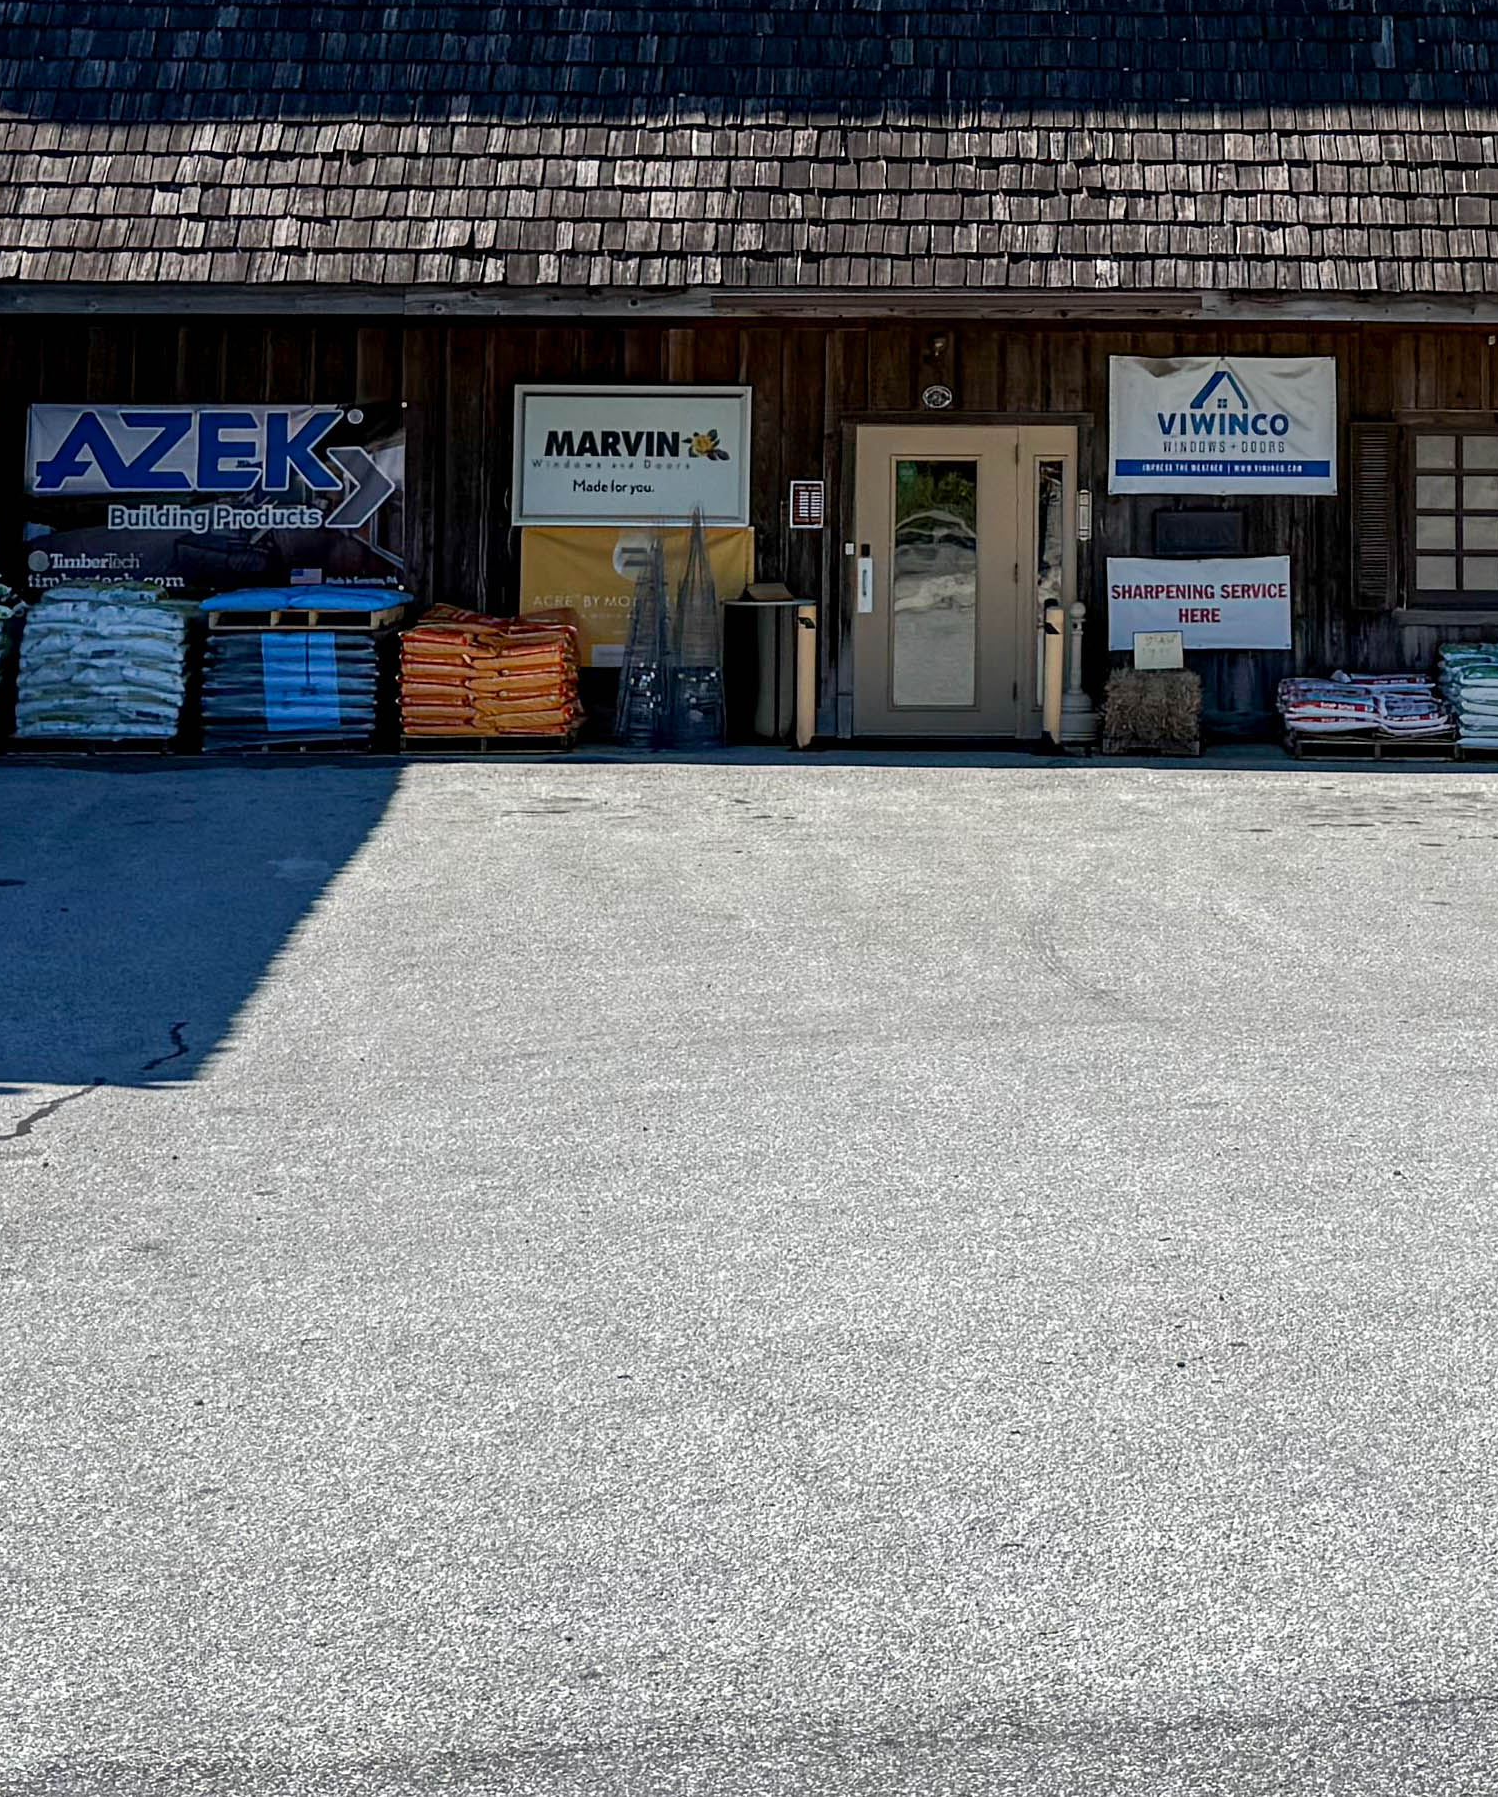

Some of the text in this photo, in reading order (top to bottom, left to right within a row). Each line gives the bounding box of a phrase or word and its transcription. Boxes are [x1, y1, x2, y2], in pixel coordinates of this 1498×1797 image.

[1157, 412, 1290, 436] VIWINCO
[32, 409, 345, 492] AZEK
[543, 430, 681, 458] MARVIN
[1163, 440, 1226, 453] WINDOWS
[1241, 441, 1285, 453] DOORS
[572, 480, 608, 493] Made
[108, 505, 323, 534] Building Products
[50, 552, 140, 569] TimberTech
[1111, 583, 1288, 601] SHARPENING SERVICE
[583, 594, 600, 608] BY
[1178, 608, 1221, 623] HERE
